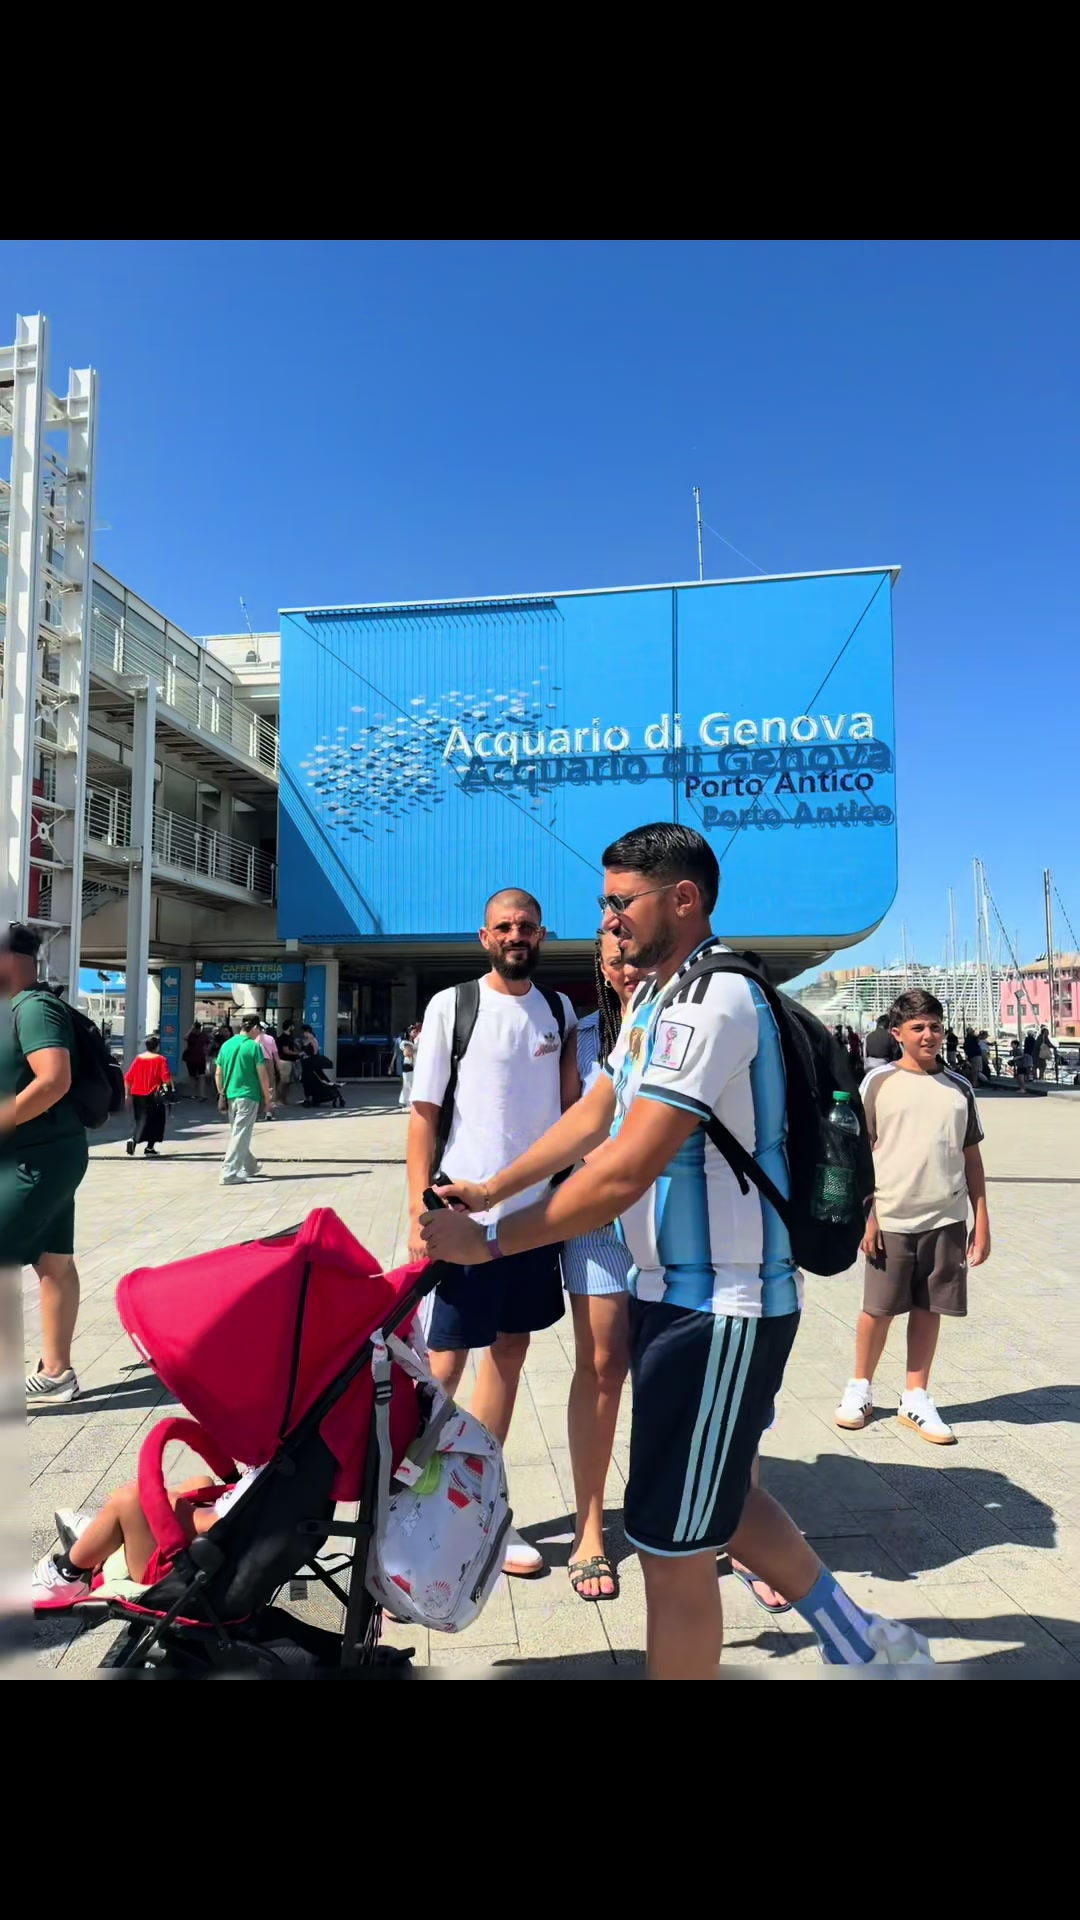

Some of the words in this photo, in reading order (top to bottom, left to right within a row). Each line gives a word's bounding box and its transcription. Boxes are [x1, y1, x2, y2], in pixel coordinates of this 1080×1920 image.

[442, 717, 630, 766] Acquario
[644, 713, 682, 749] di
[700, 712, 874, 747] Genova
[684, 776, 763, 799] Porto
[774, 768, 874, 795] Antico
[220, 972, 256, 981] COFFEE
[257, 972, 283, 981] SHOP
[222, 964, 283, 972] CAFFETTERIA
